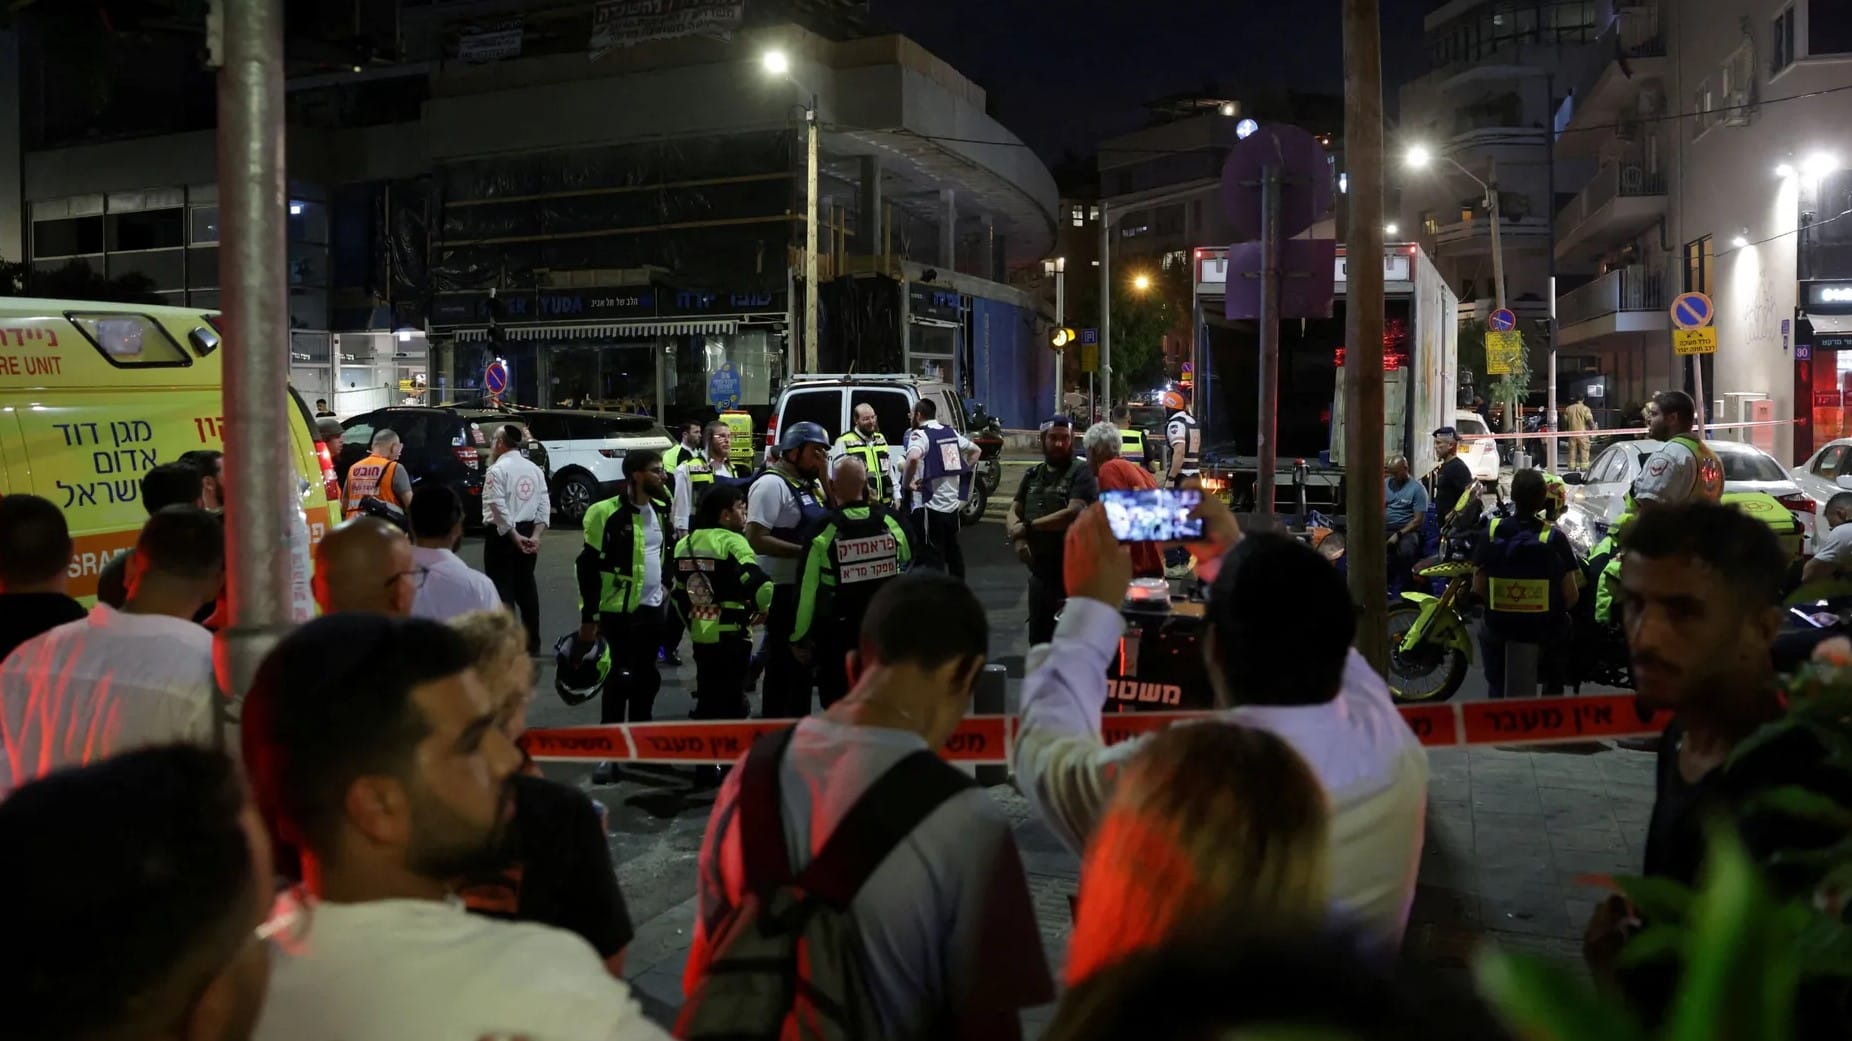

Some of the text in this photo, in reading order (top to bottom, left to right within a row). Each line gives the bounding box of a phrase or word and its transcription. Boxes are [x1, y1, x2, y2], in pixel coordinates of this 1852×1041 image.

[24, 356, 61, 375] UNIT
[52, 420, 152, 448] מגן דוד
[93, 448, 157, 474] אדום
[353, 466, 379, 477] חובש
[839, 538, 895, 560] פראמדיק
[843, 562, 894, 579] מפקד מד"א
[1107, 679, 1182, 705] משטר
[1485, 704, 1613, 733] אין מעבר
[646, 736, 740, 757] אין מעבר
